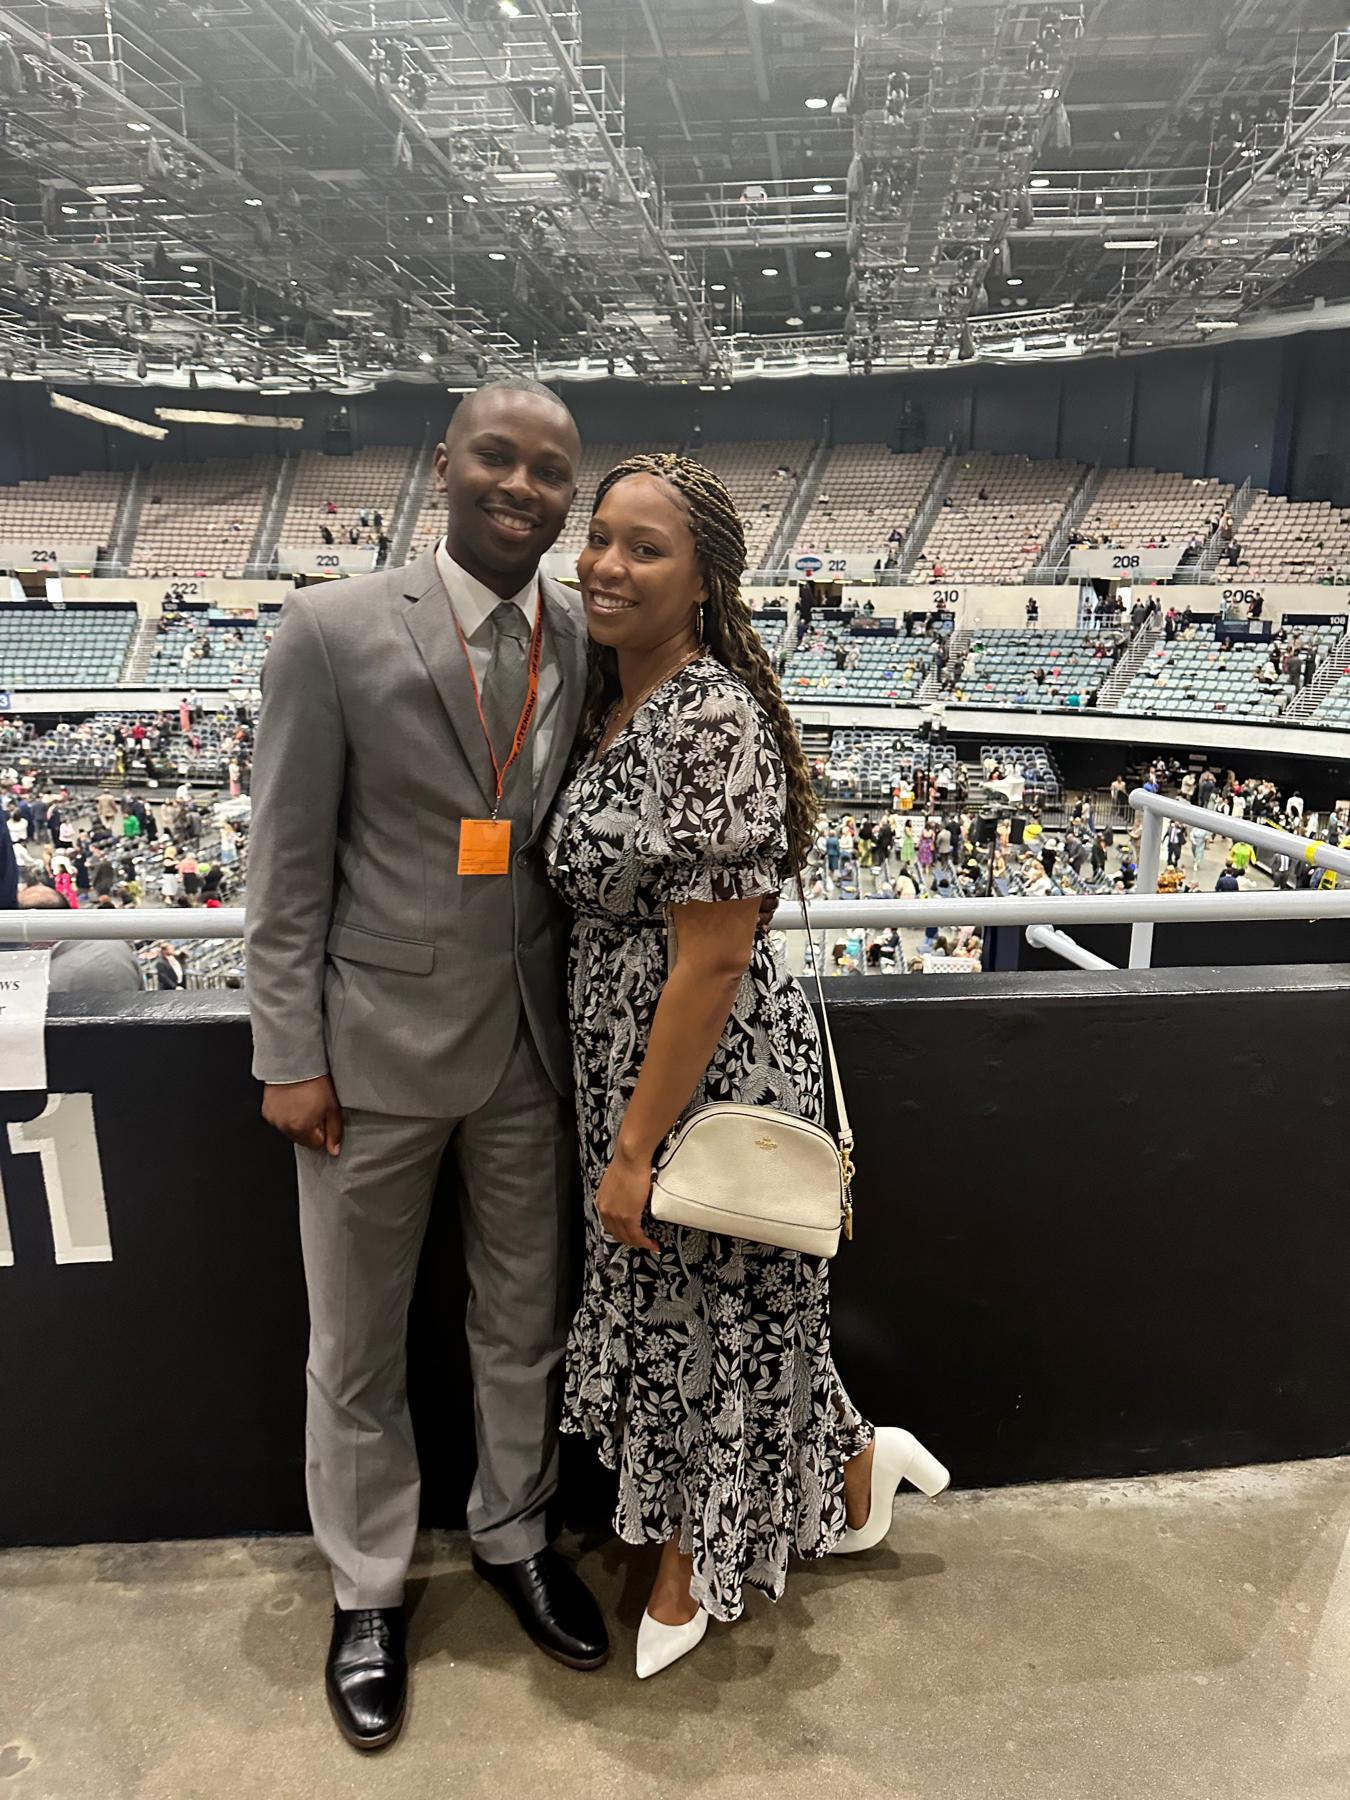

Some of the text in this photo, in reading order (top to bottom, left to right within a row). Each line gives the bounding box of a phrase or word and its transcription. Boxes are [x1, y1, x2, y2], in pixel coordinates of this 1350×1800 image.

[32, 550, 57, 562] 224
[316, 555, 340, 567] 220
[1113, 555, 1140, 568] 208
[828, 559, 847, 571] 212
[171, 582, 198, 595] 222
[933, 590, 959, 603] 210
[1223, 589, 1256, 604] 206
[1330, 616, 1346, 625] 108
